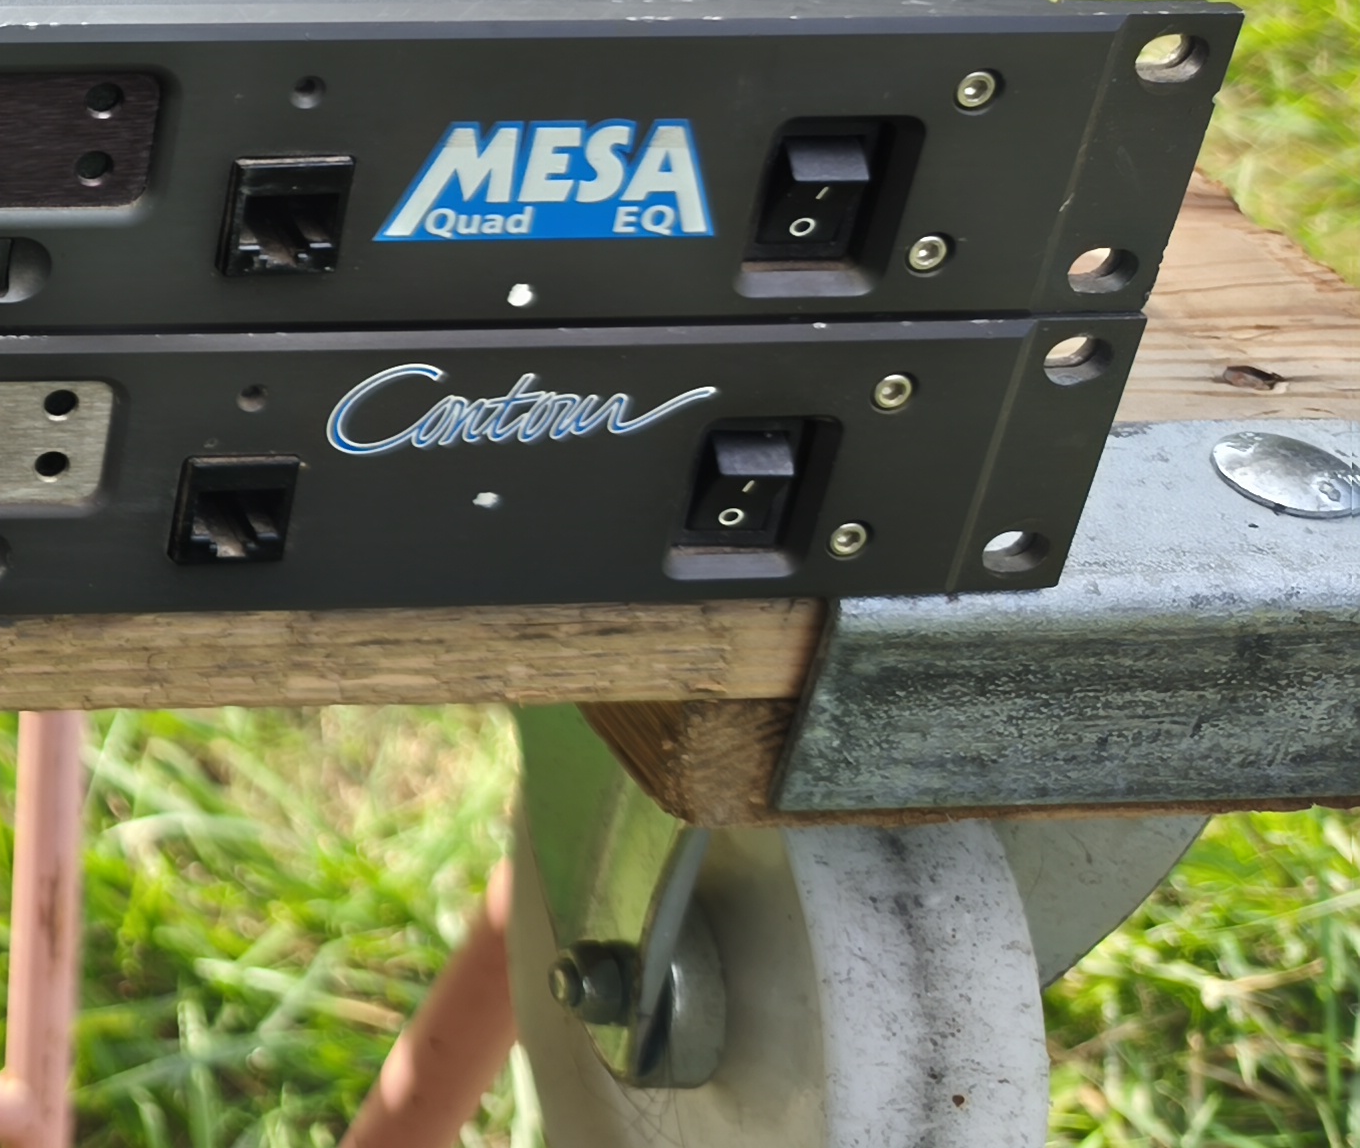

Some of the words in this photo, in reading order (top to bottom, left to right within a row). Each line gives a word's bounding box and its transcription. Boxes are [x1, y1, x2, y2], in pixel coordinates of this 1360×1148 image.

[383, 125, 707, 237] MESA
[423, 206, 533, 239] Quad
[613, 204, 676, 236] EQ
[326, 363, 717, 454] Contour
